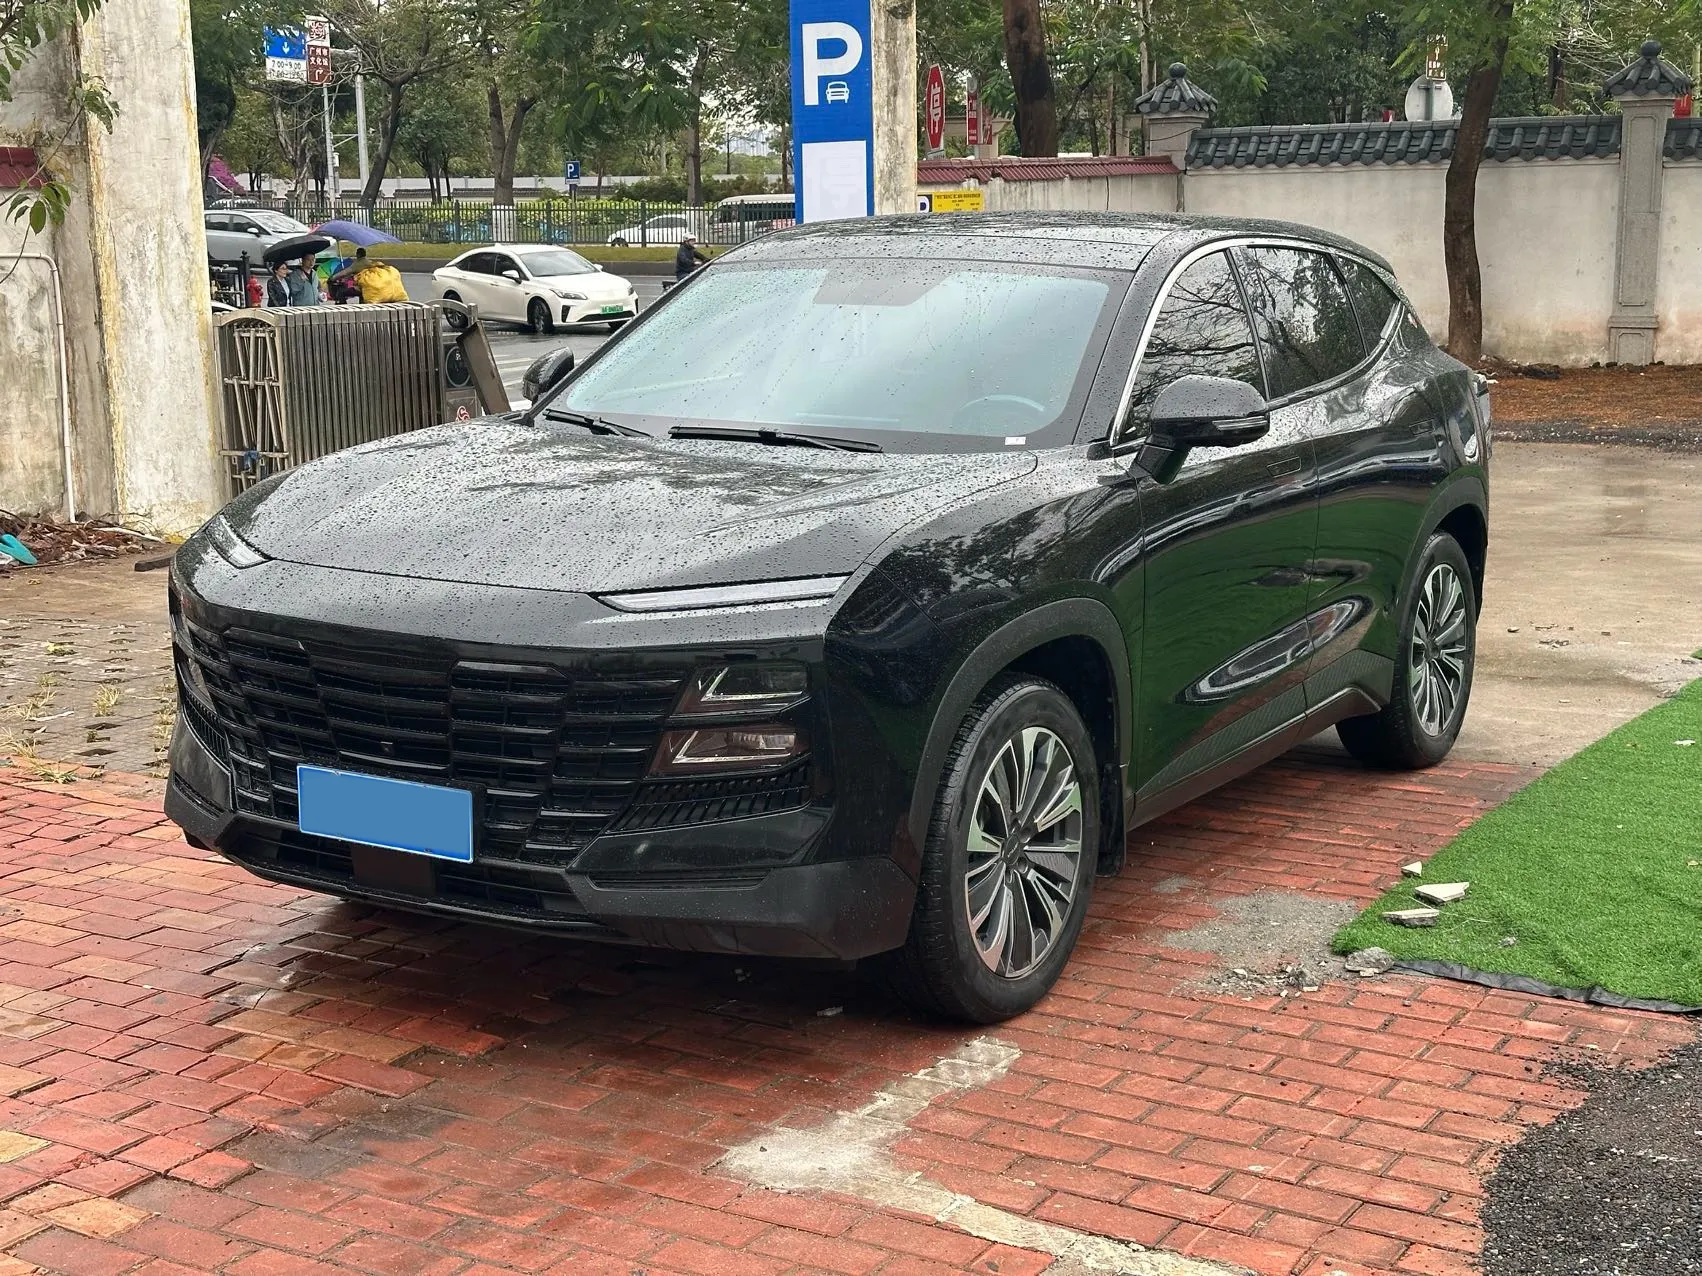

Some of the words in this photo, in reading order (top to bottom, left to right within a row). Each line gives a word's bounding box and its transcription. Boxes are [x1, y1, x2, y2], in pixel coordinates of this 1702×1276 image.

[802, 22, 862, 105] P
[930, 82, 941, 134] 停
[567, 163, 574, 178] P
